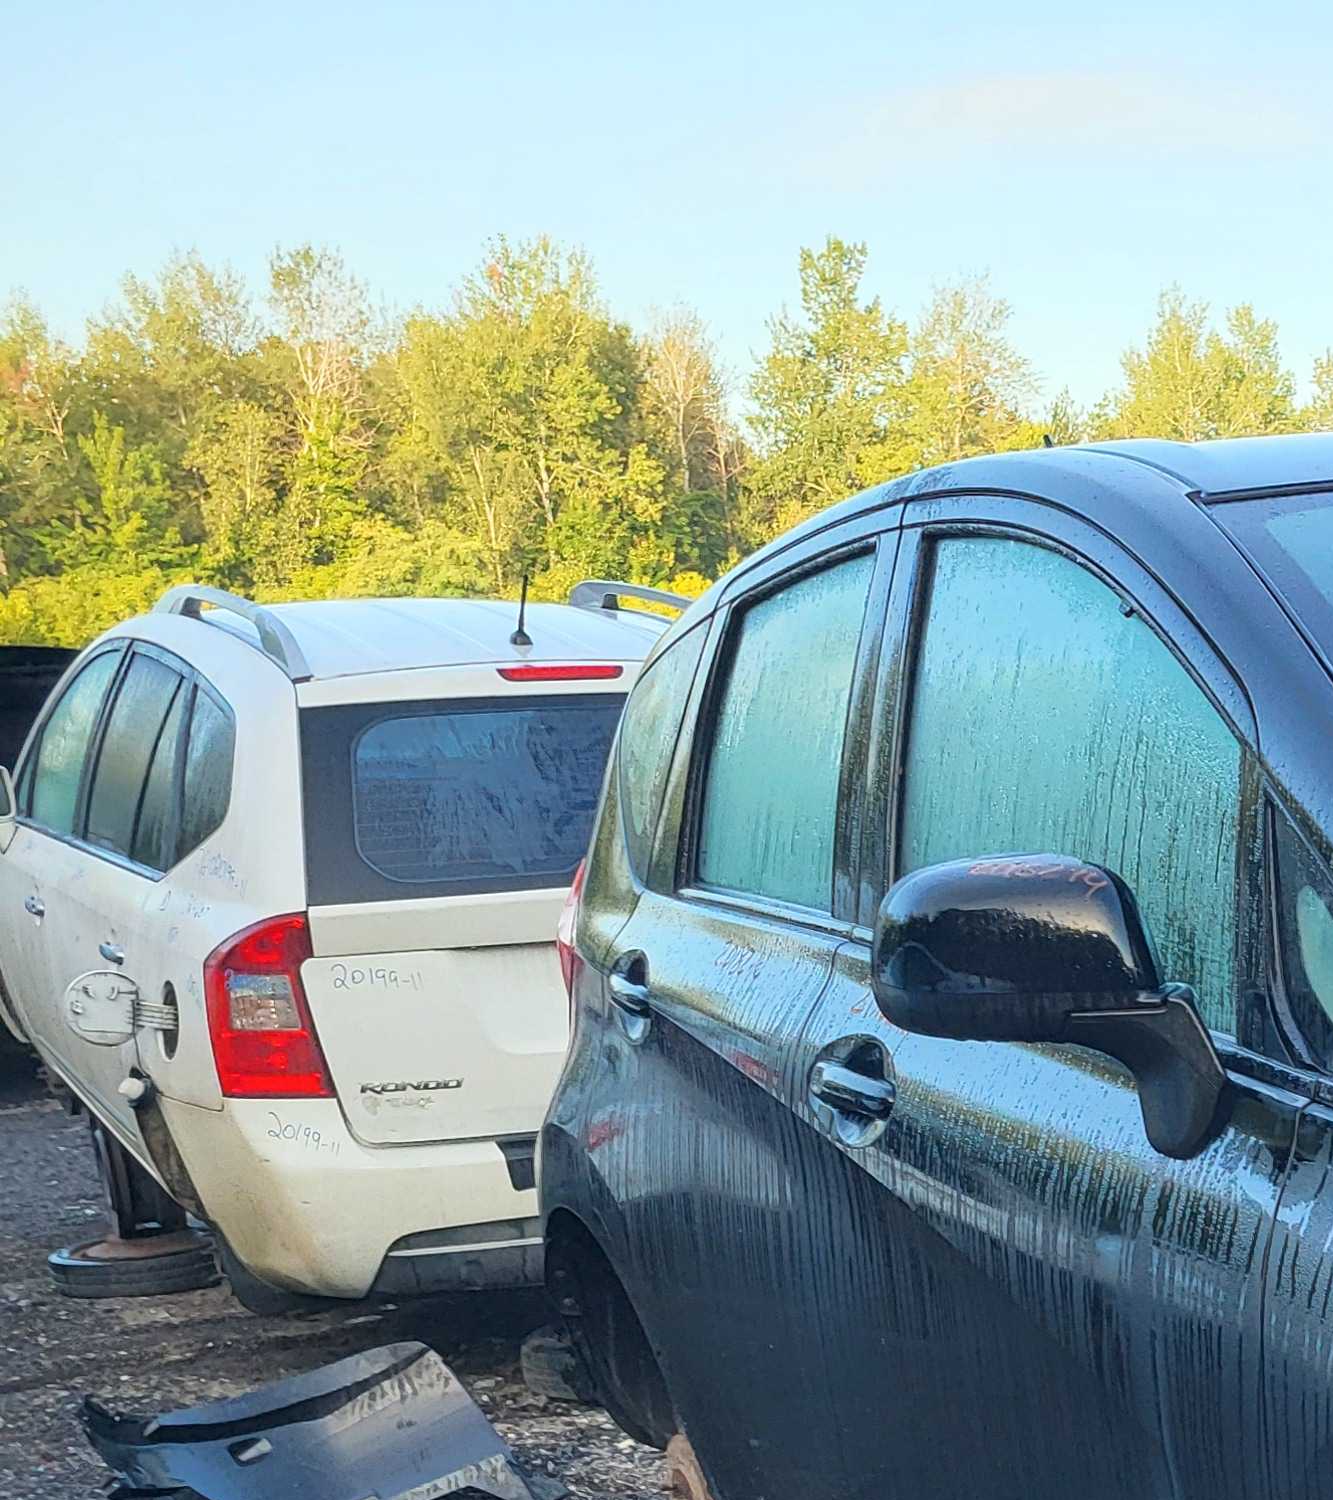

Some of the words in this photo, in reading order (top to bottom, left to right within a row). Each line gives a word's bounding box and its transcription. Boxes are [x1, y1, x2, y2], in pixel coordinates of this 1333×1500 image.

[331, 963, 423, 990] 20199-11
[359, 1078, 464, 1095] RONDO
[267, 1111, 340, 1157] 20199-11
